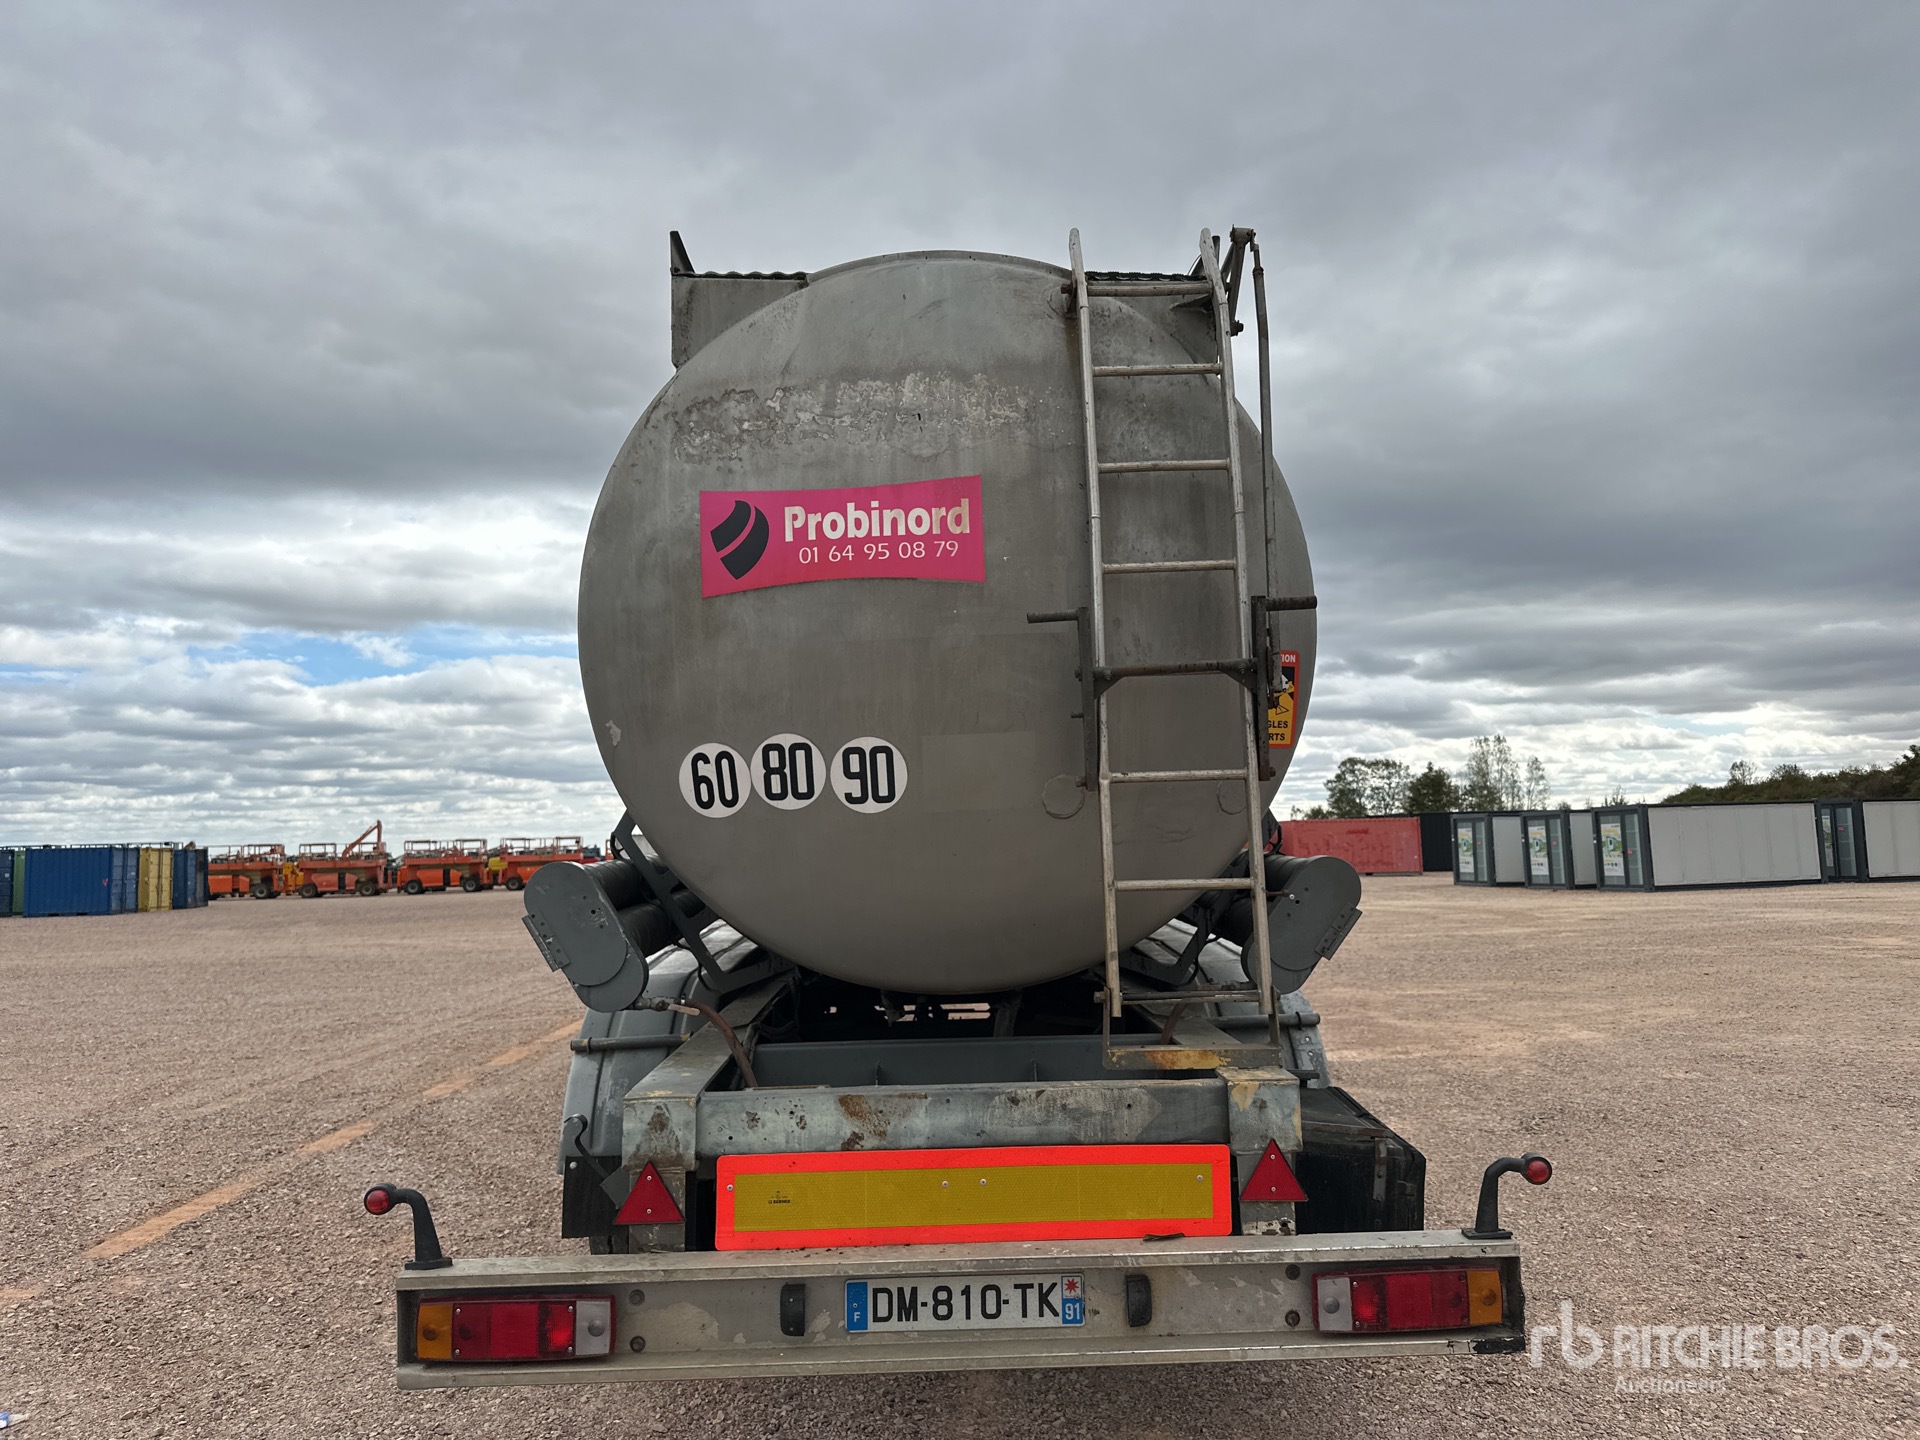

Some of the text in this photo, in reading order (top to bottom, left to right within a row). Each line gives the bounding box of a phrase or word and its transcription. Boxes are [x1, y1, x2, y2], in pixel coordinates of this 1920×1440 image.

[784, 498, 970, 542] Probinord
[799, 540, 959, 564] 01 64 95 08 79
[1281, 654, 1296, 663] ION
[1268, 721, 1288, 729] GLES
[1269, 733, 1285, 741] RTS
[691, 750, 739, 810] 60
[762, 742, 815, 801] 80
[842, 745, 896, 805] 90
[872, 1282, 1060, 1323] DM-810-TK
[1064, 1303, 1081, 1321] 91
[853, 1312, 861, 1323] F
